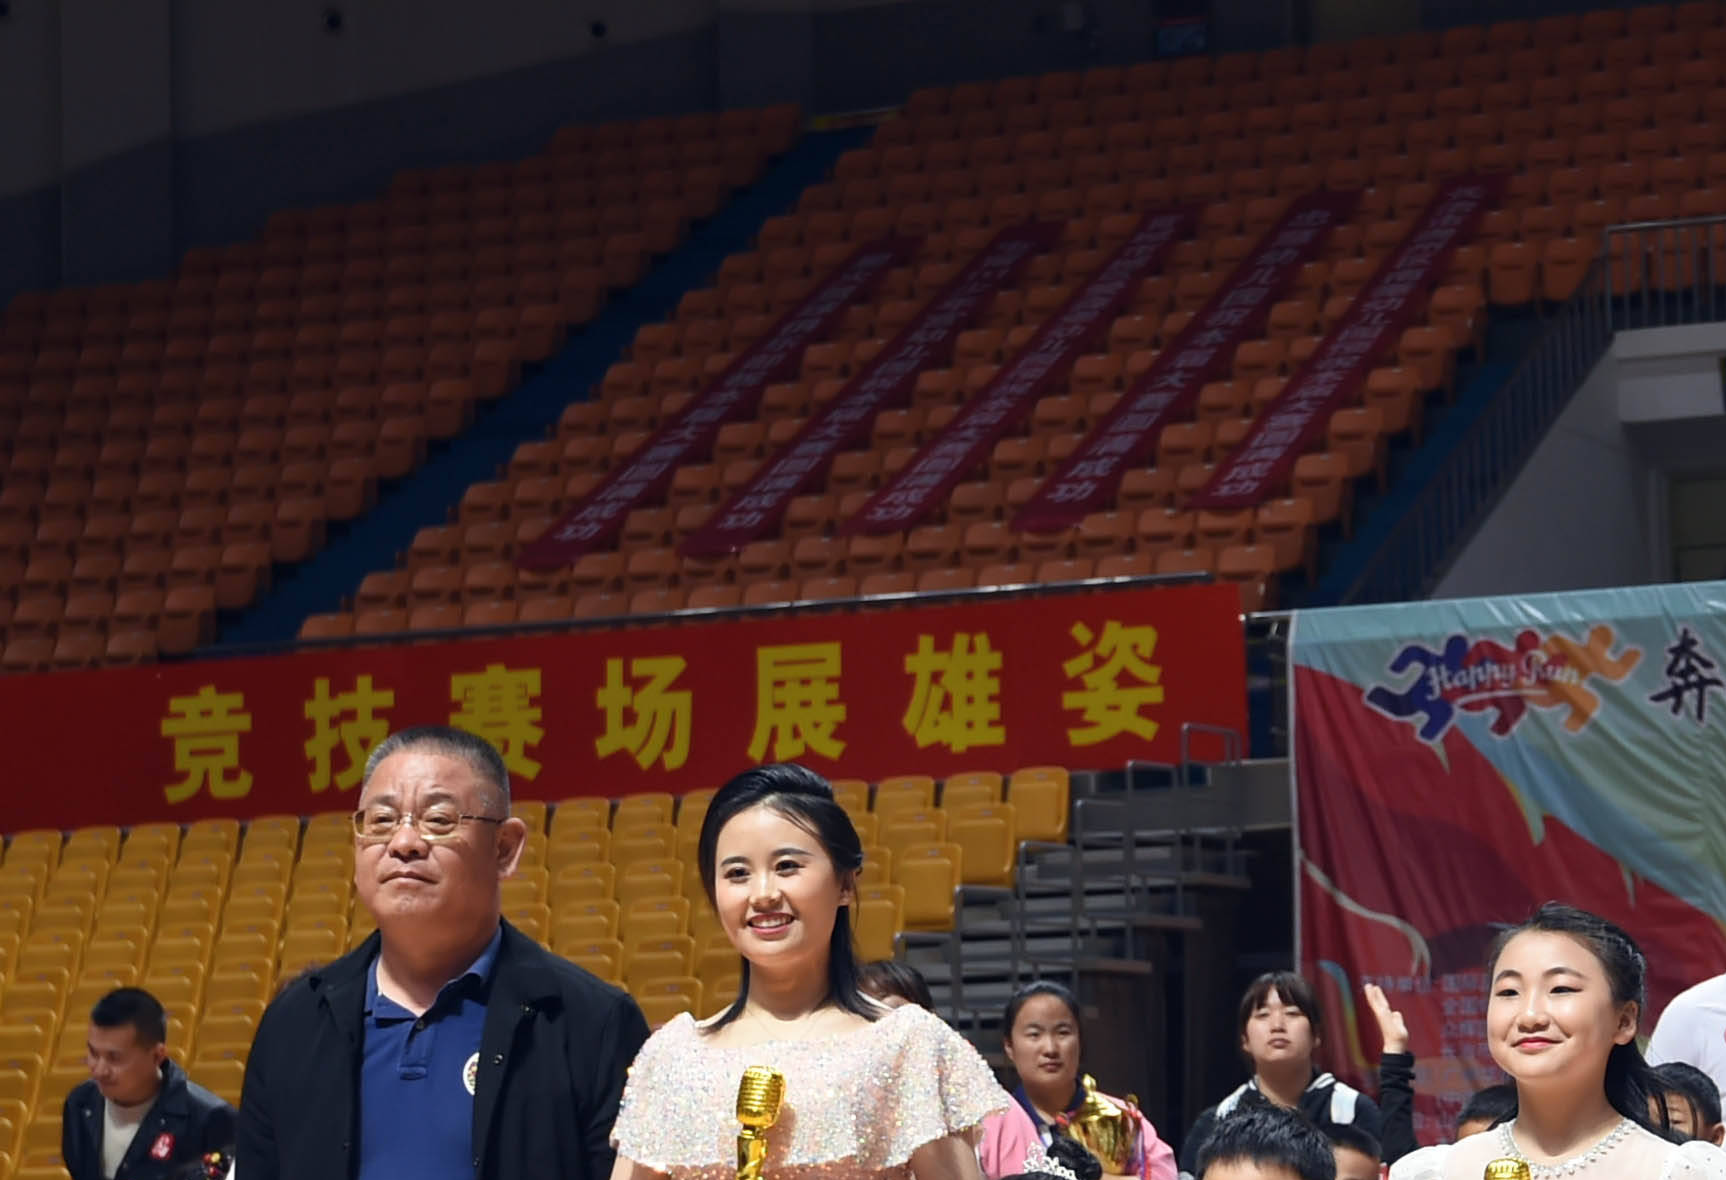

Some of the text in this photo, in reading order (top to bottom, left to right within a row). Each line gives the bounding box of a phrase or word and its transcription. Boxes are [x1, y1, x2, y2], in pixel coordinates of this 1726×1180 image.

[162, 618, 1165, 803] 竞技赛场展雄姿
[1426, 657, 1517, 699] Happy
